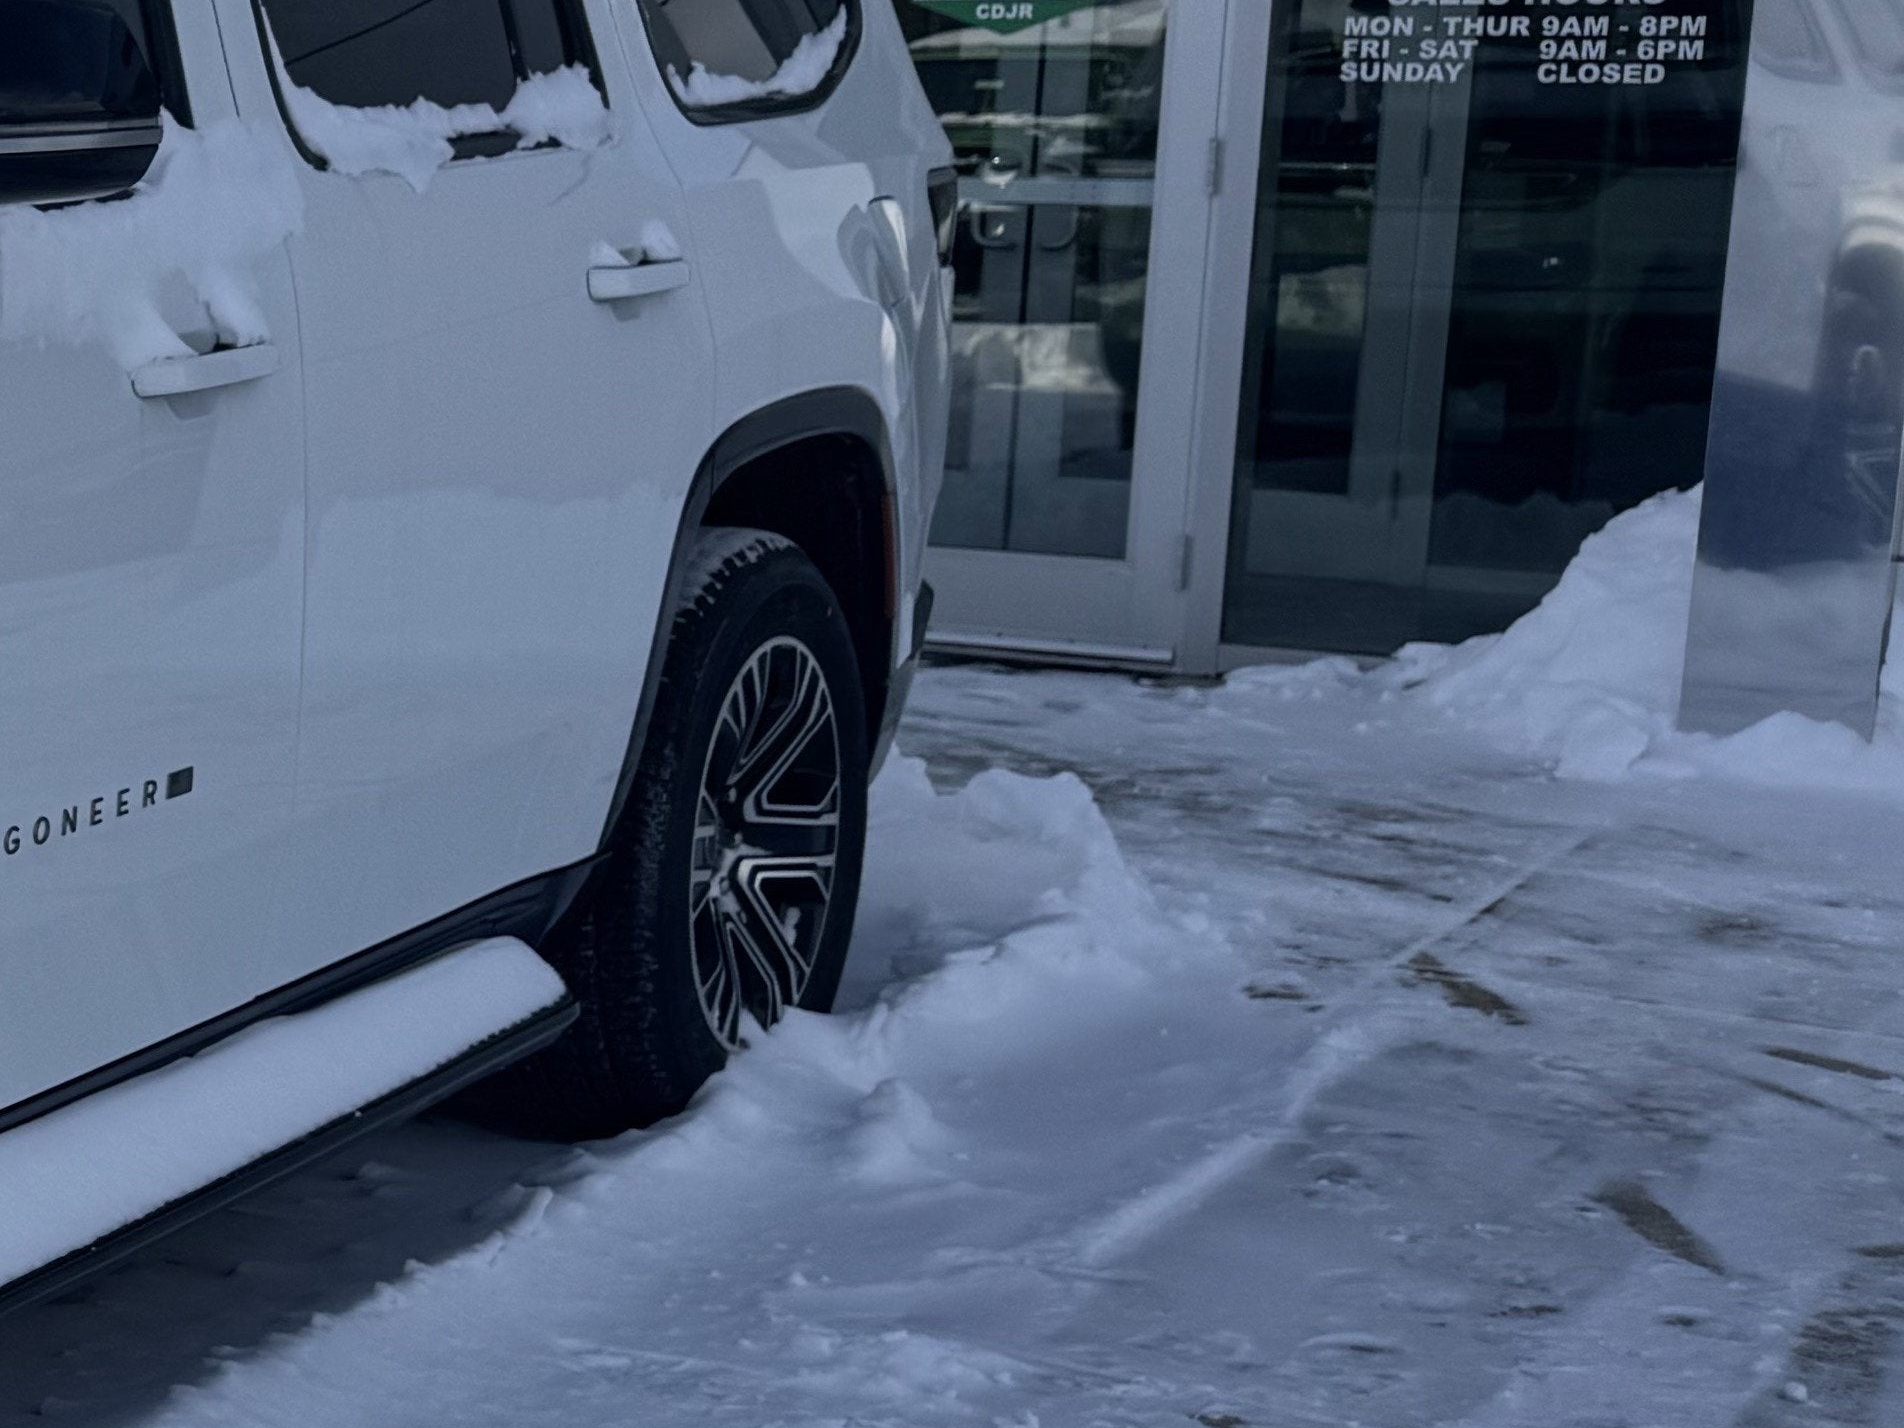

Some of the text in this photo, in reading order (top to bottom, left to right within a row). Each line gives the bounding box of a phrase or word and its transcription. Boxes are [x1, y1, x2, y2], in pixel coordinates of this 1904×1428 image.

[975, 3, 1034, 20] CDJR
[1344, 15, 1414, 37] MON
[1443, 15, 1531, 37] THUR
[1542, 15, 1609, 37] 9AM
[1639, 15, 1707, 37] 8PM
[1343, 38, 1391, 59] FRI
[1419, 38, 1479, 60] SAT
[1539, 39, 1607, 60] 9AM
[1637, 39, 1705, 61] 6PM
[1340, 61, 1666, 84] SUNDAY CLOSED
